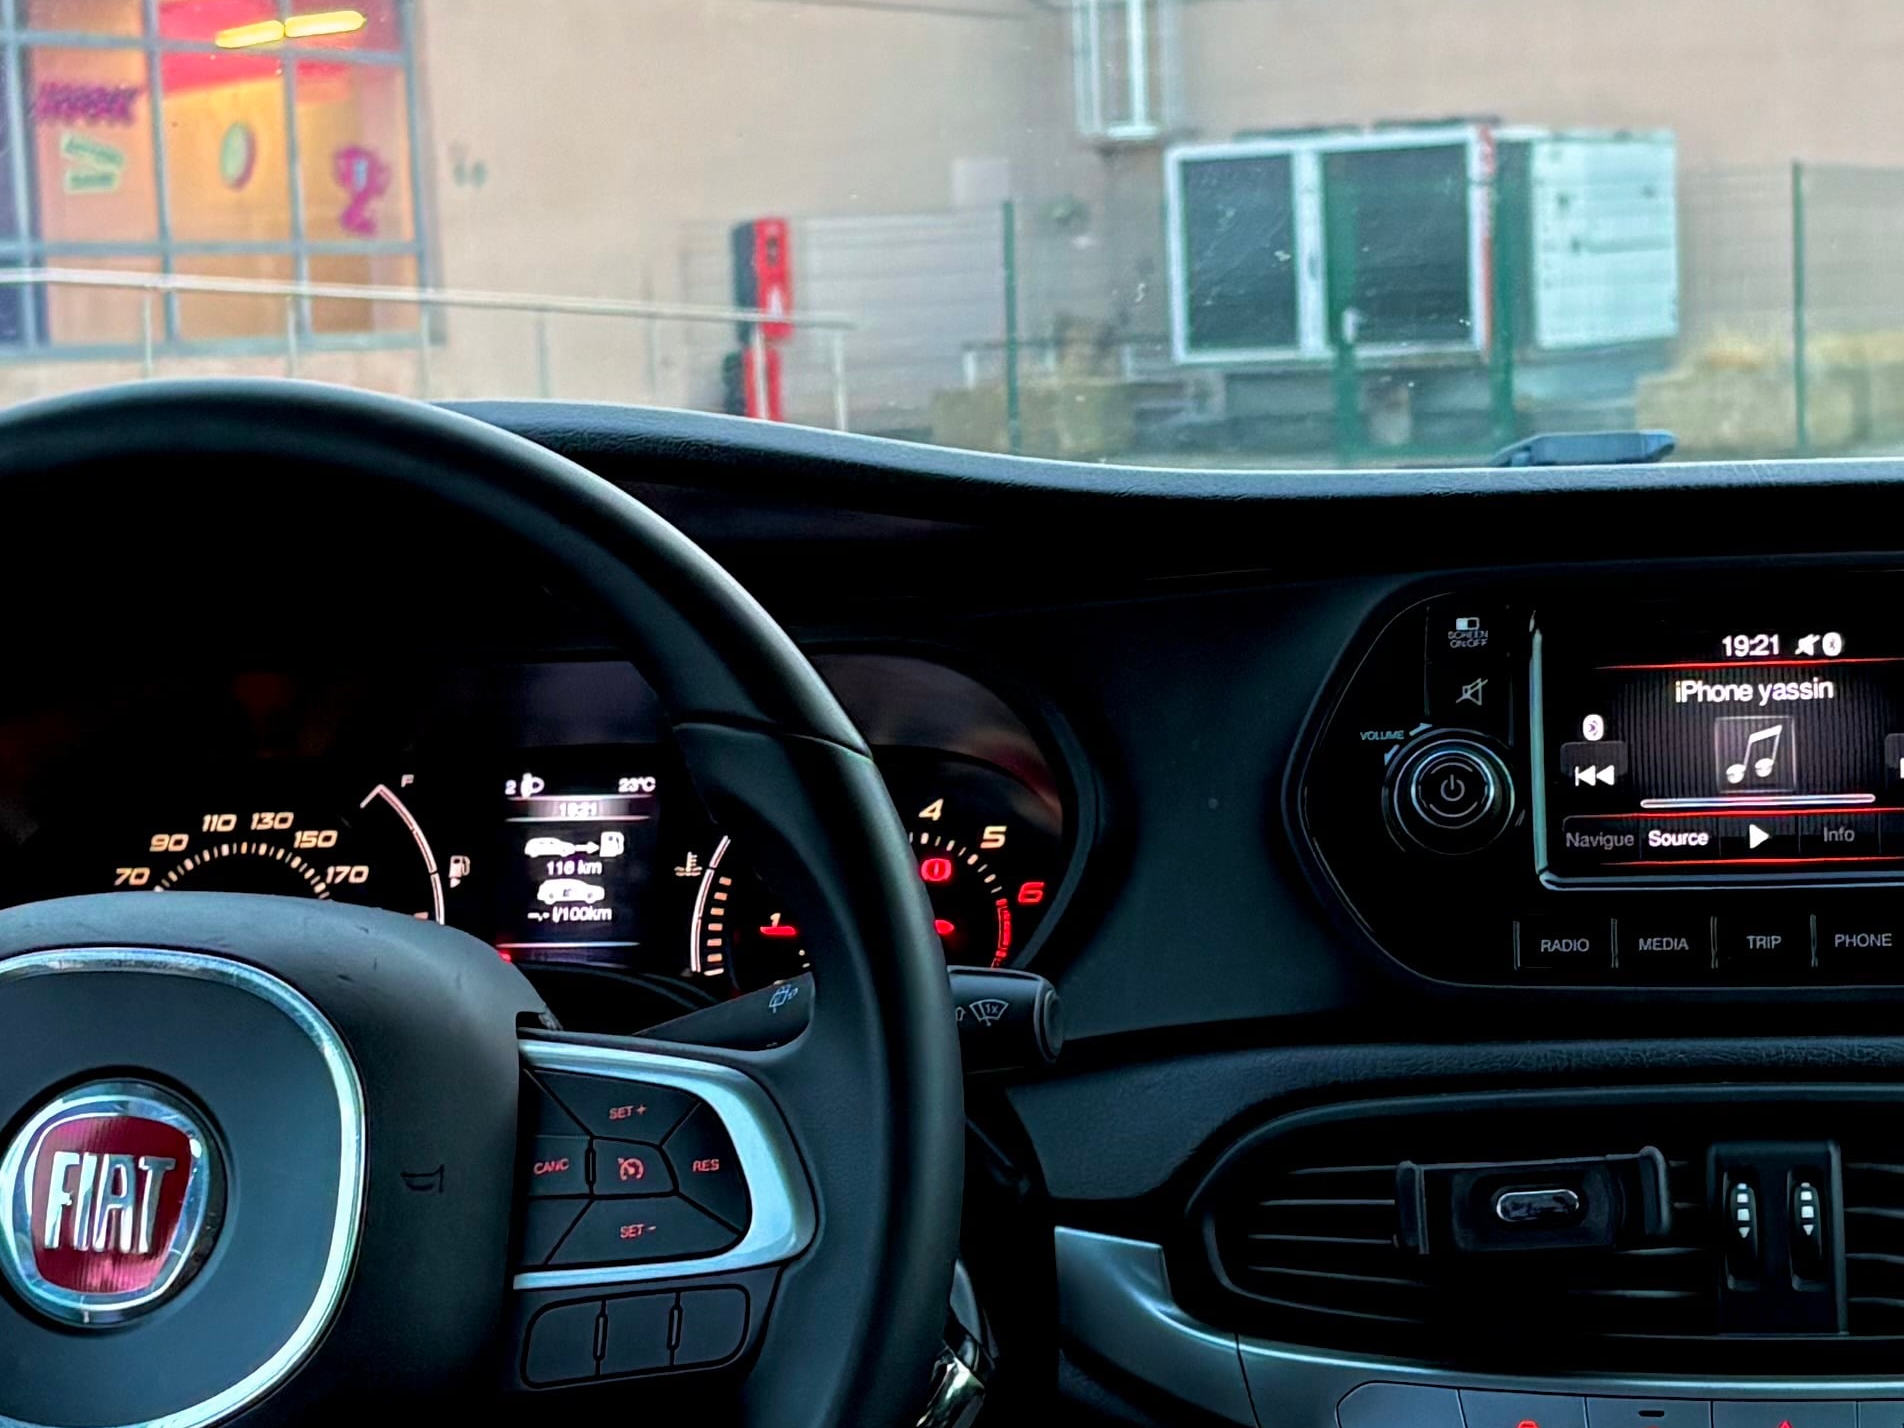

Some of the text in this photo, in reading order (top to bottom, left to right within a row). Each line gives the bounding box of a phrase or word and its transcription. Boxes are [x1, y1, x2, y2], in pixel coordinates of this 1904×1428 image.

[1721, 634, 1780, 657] 19:21
[1675, 677, 1834, 706] iPhone yassin
[1360, 730, 1405, 741] VOLUME
[918, 798, 944, 821] 4
[202, 814, 237, 832] 110
[250, 812, 294, 830] 130
[149, 833, 189, 852] 90
[293, 830, 338, 849] 150
[980, 825, 1007, 849] 5
[1565, 831, 1634, 849] Navigue
[1648, 828, 1709, 847] Source
[1823, 826, 1855, 843] Info
[325, 865, 369, 884] 170
[577, 859, 603, 875] km
[114, 867, 150, 886] 70
[1018, 882, 1044, 903] 6
[1540, 938, 1590, 952] RADIO
[1638, 937, 1689, 951] MEDIA
[1746, 935, 1782, 950] TRIP
[1834, 933, 1893, 948] PHONE
[609, 1105, 634, 1120] SET
[692, 1158, 720, 1172] RES
[44, 1151, 176, 1254] FIAT
[620, 1224, 645, 1238] SET
